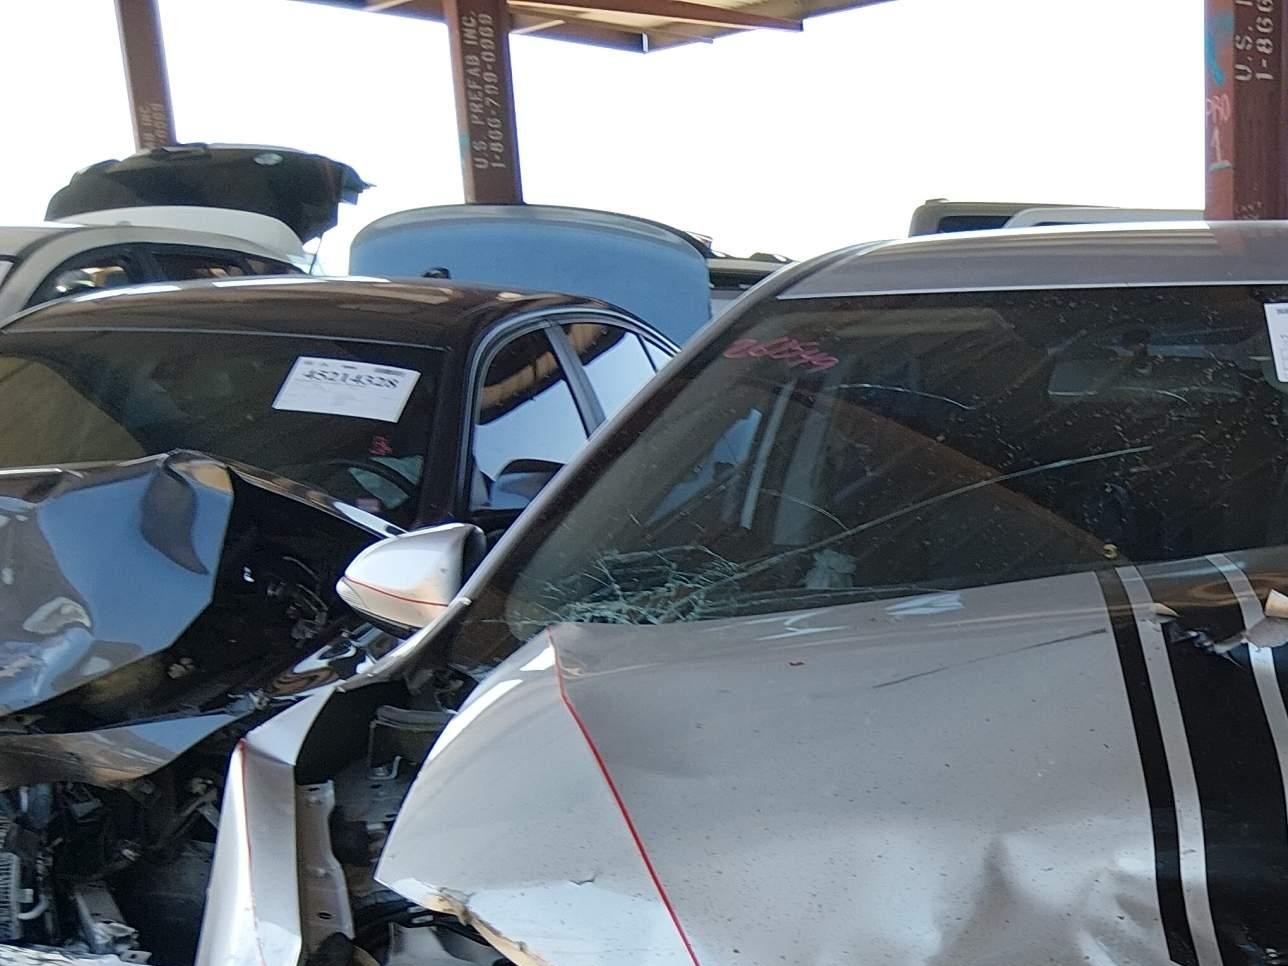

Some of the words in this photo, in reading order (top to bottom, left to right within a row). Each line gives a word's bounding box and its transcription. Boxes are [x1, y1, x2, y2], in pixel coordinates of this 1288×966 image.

[1234, 26, 1253, 81] U.S.
[464, 54, 486, 126] PREFAB
[471, 136, 489, 169] U.S.
[302, 368, 400, 389] 45214328
